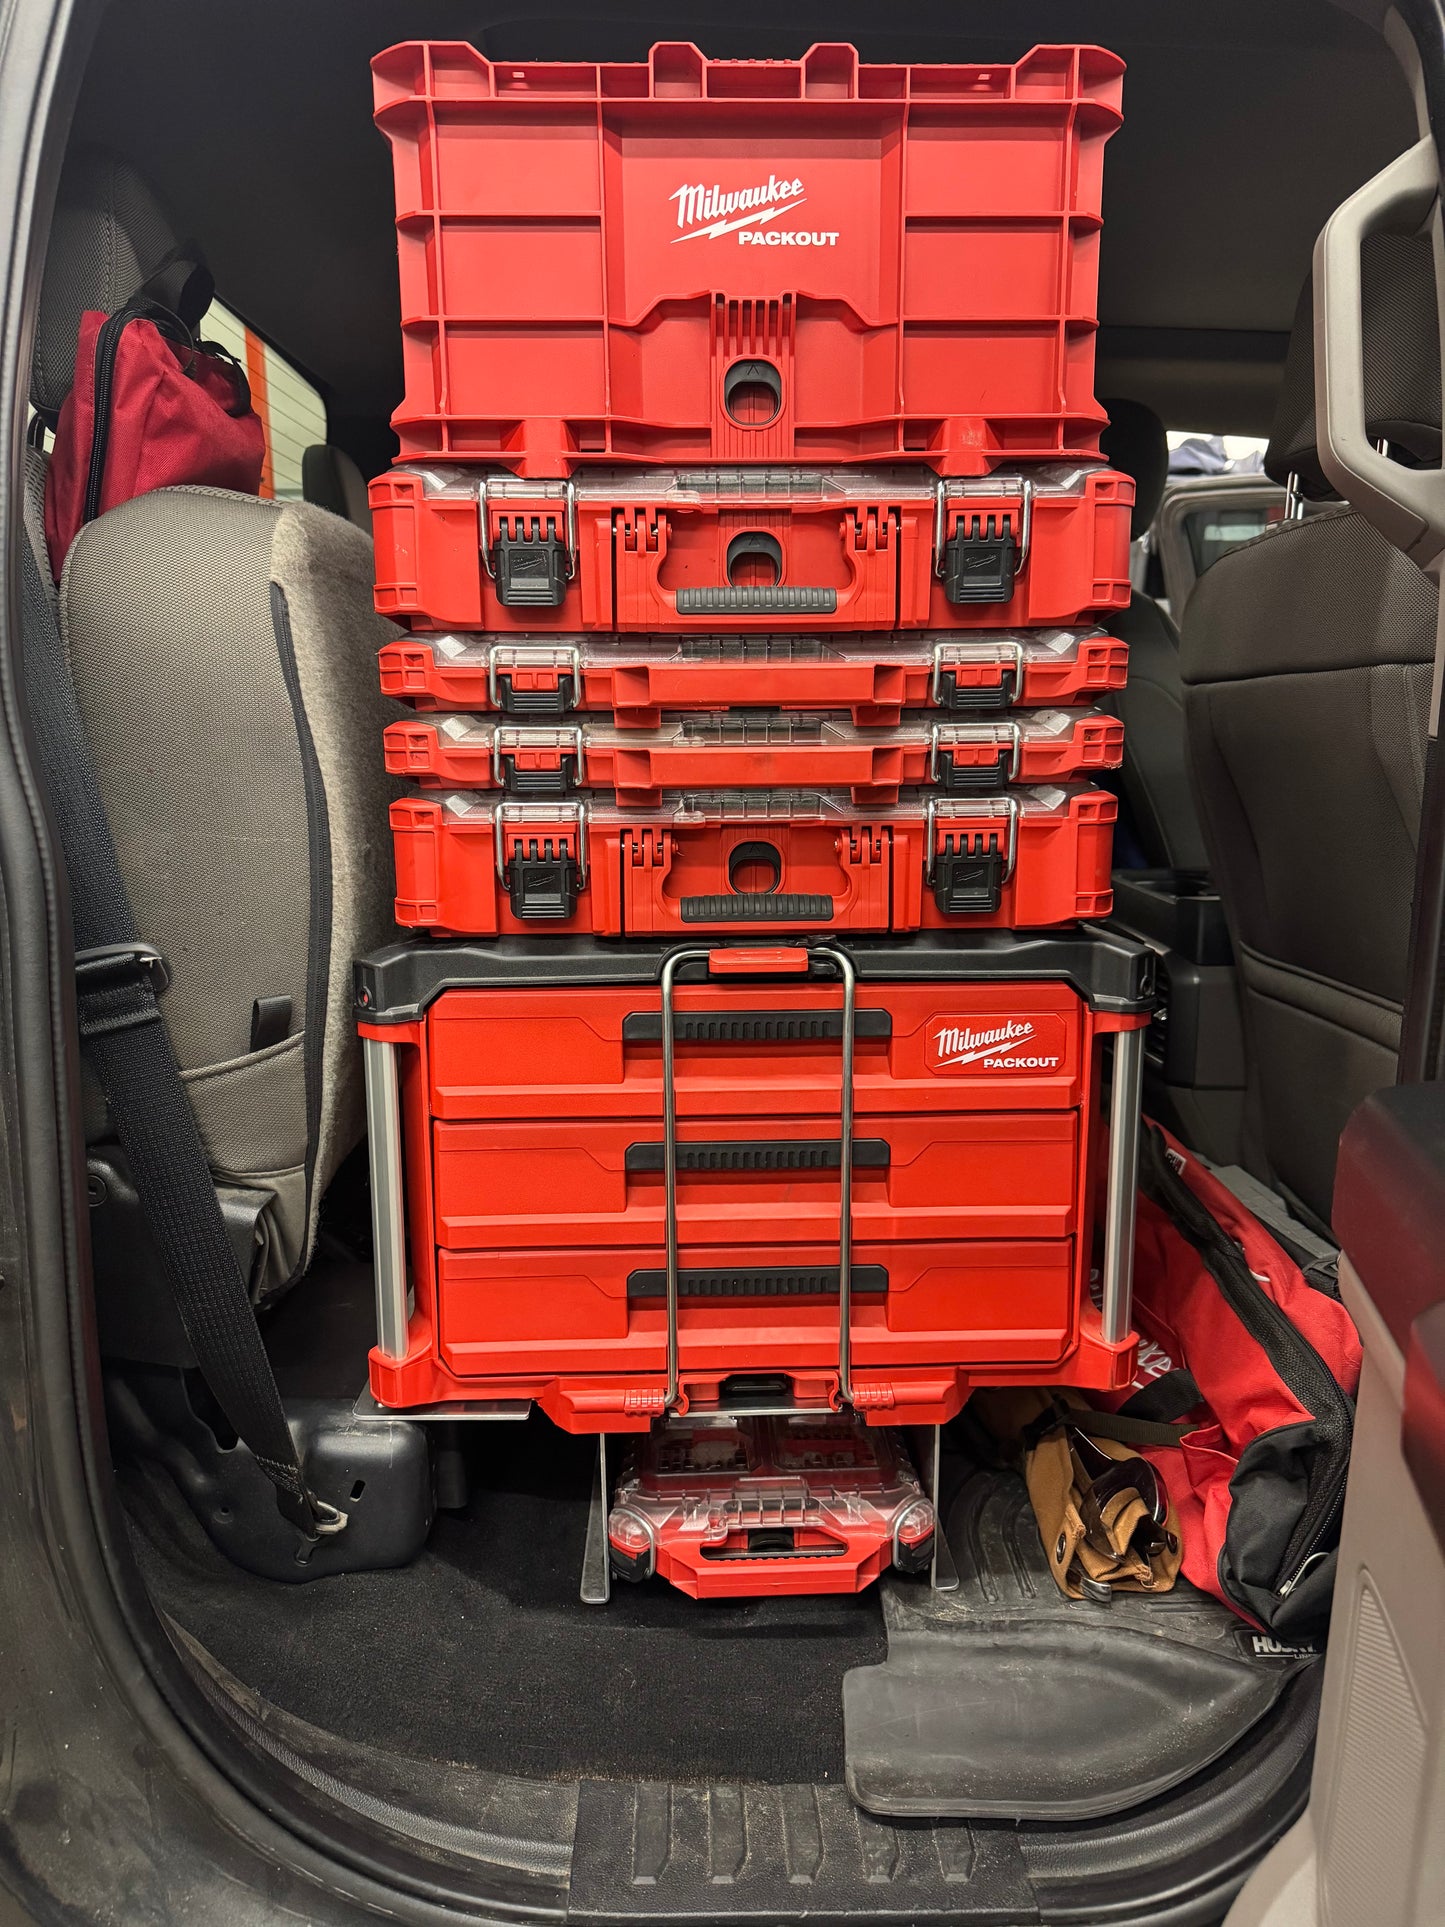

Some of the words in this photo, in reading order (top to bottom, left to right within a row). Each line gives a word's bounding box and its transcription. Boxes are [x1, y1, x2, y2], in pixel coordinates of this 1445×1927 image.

[668, 174, 805, 229] Milwaukee
[738, 231, 840, 246] PACKOUT
[932, 1020, 1035, 1058] Milwaukee
[983, 1057, 1060, 1068] PACKOUT
